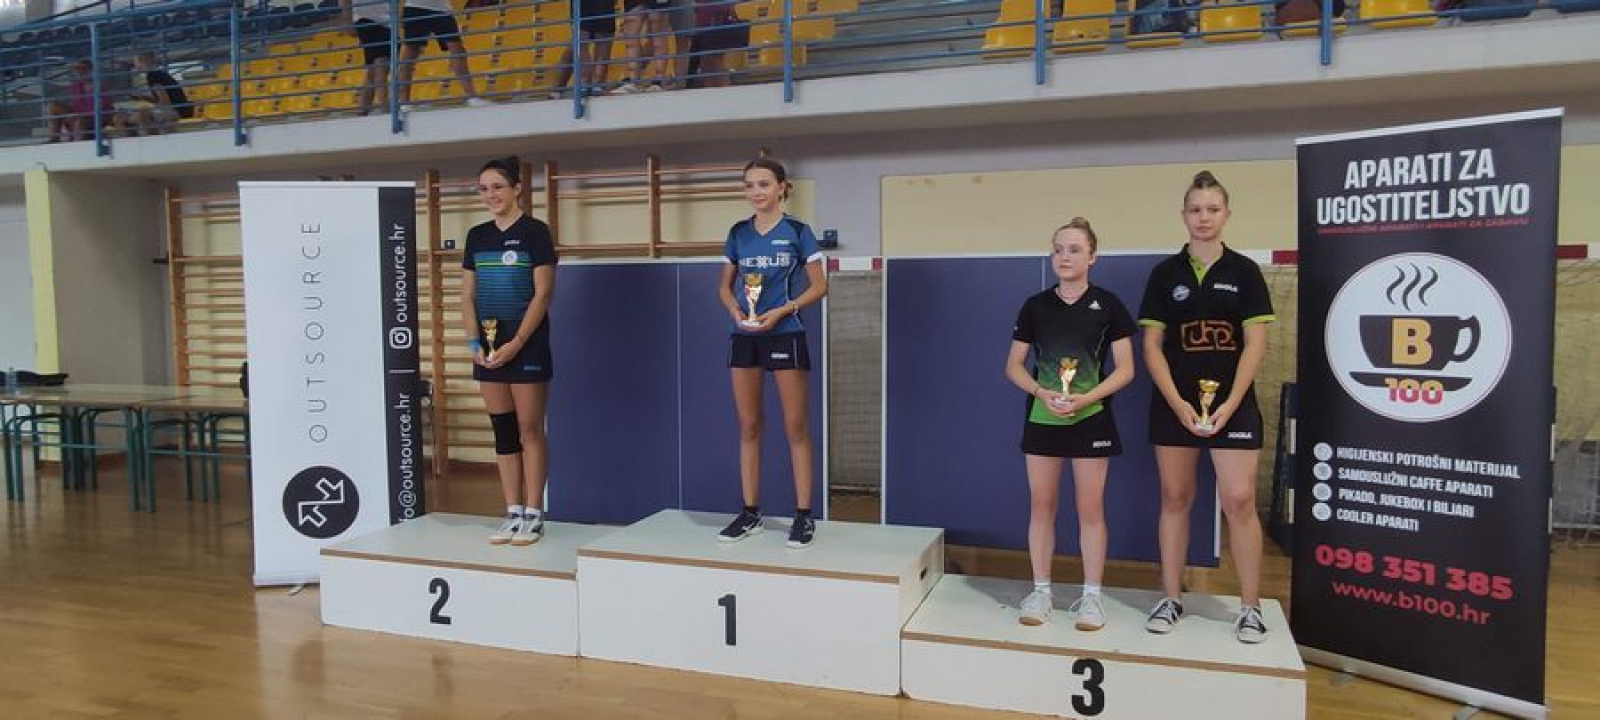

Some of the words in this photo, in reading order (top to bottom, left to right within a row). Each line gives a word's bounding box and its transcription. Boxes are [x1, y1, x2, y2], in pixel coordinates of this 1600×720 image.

[1344, 152, 1452, 190] APARATI
[1458, 148, 1496, 181] ZA
[1316, 183, 1530, 226] UGOSTITELJSTVO
[388, 223, 408, 323] outsource.hr
[301, 222, 328, 443] OUTSOURCE
[1391, 317, 1433, 366] B
[1384, 377, 1444, 405] 100
[1338, 467, 1408, 488] SAMOUSLUŽNI
[1409, 475, 1443, 492] CAFFE
[1445, 479, 1493, 498] APARATI
[1396, 452, 1452, 470] POTROŠNI
[1454, 458, 1521, 479] MATERIJAL
[1336, 508, 1374, 525] COOLER
[1375, 513, 1419, 532] APARATI
[1338, 488, 1377, 505] PIKADO,
[1427, 500, 1432, 512] I
[1433, 501, 1475, 518] BILJARI
[1315, 544, 1374, 574] 098
[1382, 556, 1436, 586] 351
[1446, 567, 1514, 600] 385
[428, 577, 452, 625] 2
[717, 593, 737, 646] 1
[1332, 580, 1491, 625] www.b100.hr
[1070, 658, 1106, 718] 3
